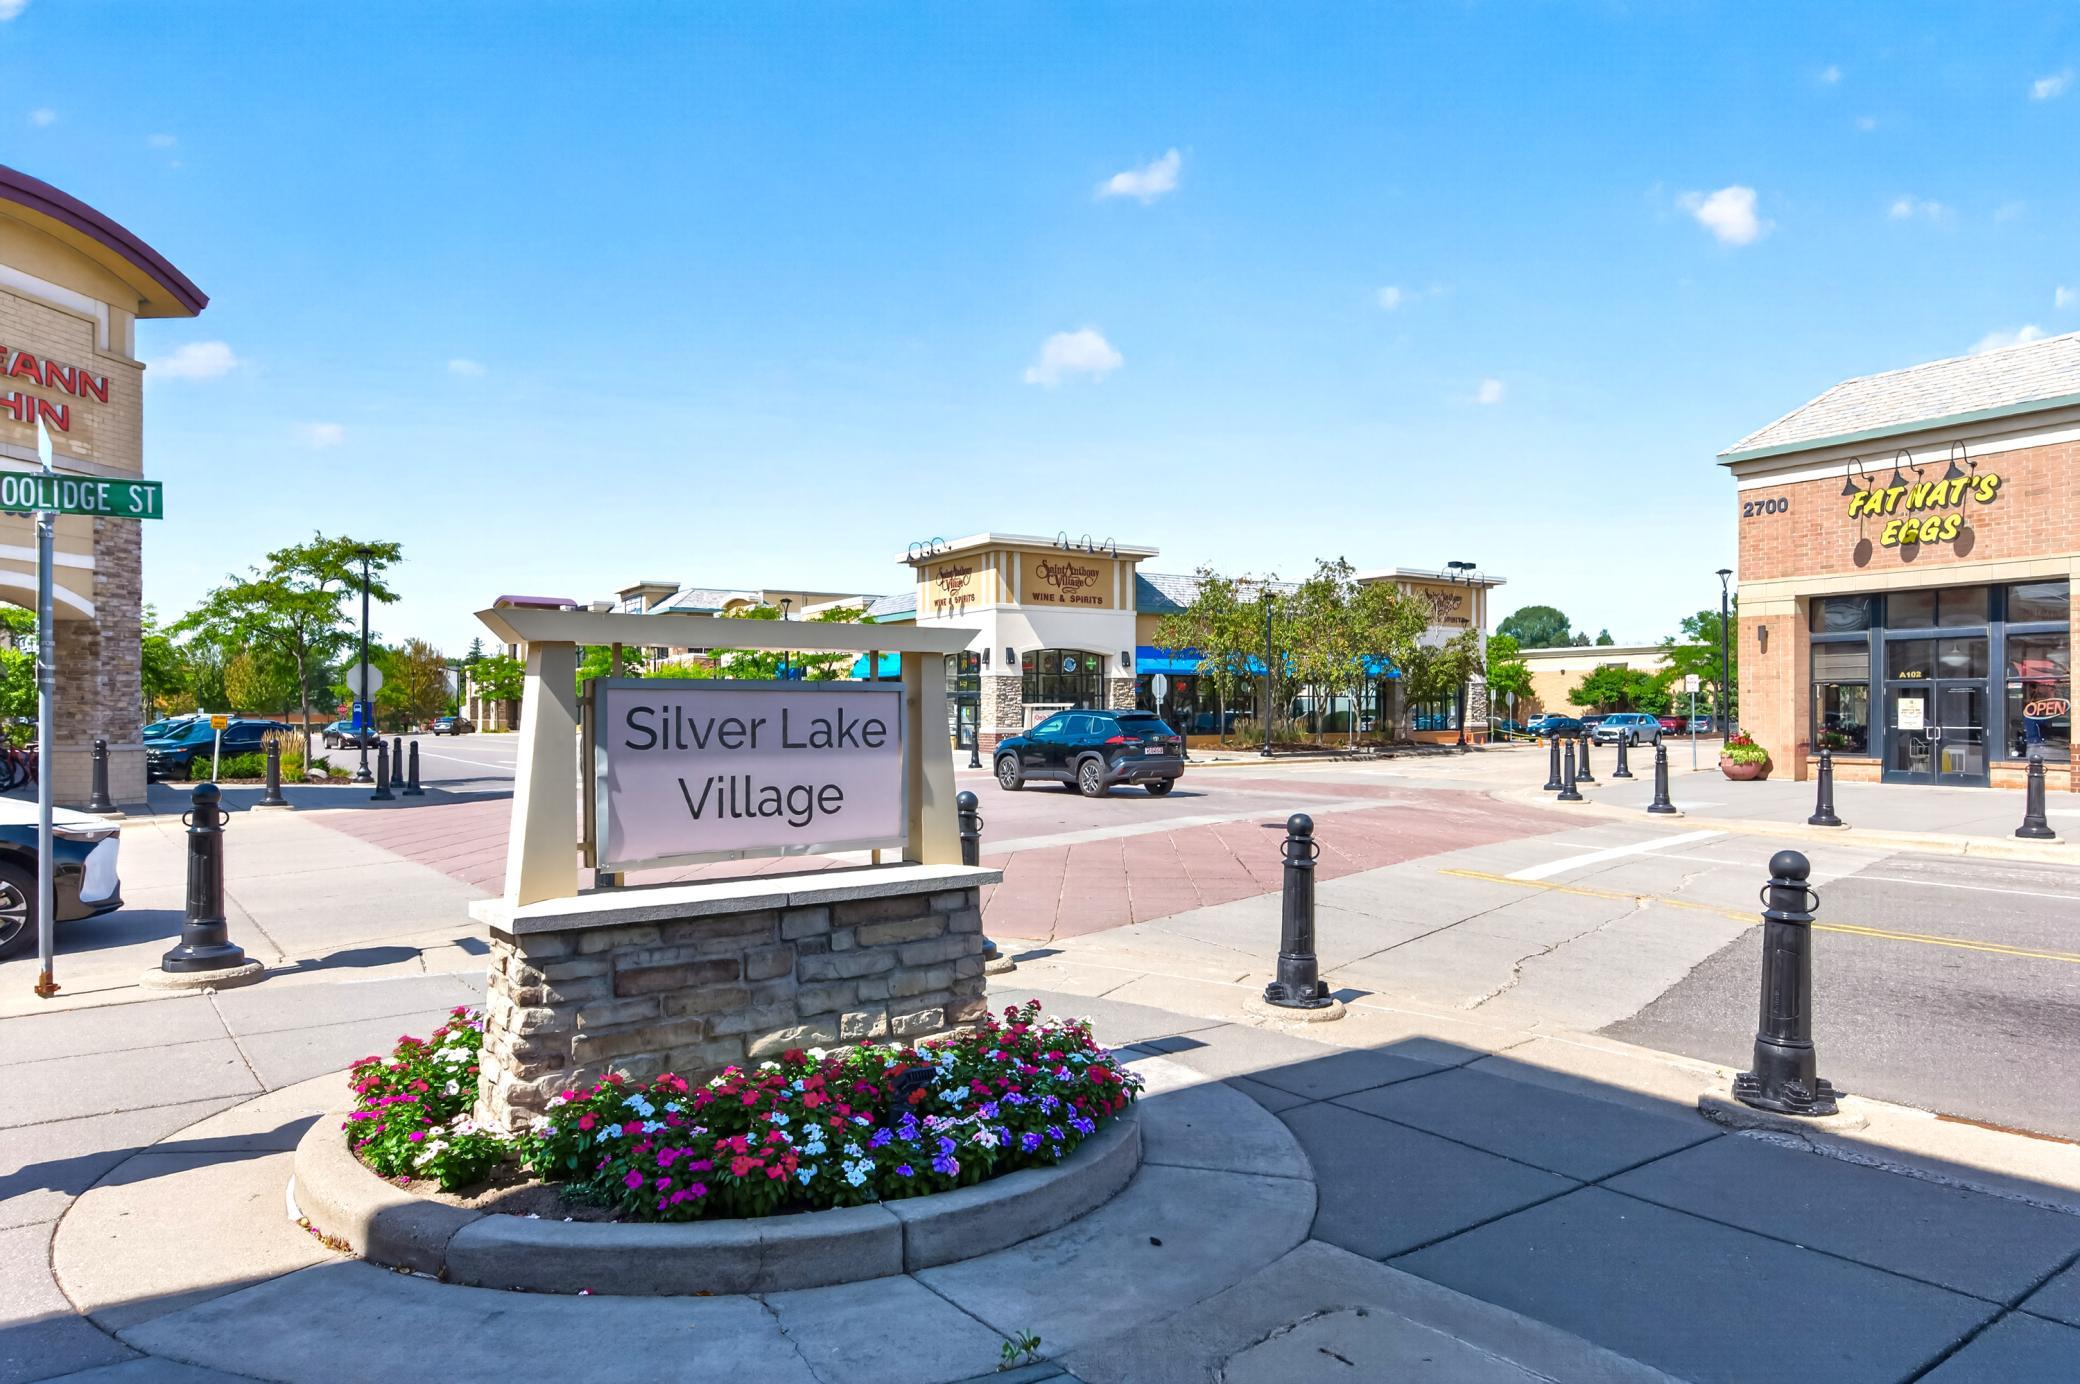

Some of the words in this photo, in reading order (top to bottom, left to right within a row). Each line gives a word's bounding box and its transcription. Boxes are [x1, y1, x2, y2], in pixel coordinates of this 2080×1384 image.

[129, 485, 156, 513] ST
[1743, 497, 1788, 518] 2700
[1848, 486, 1906, 518] FAT
[1905, 473, 2001, 510] NAT'S
[1880, 513, 1962, 547] EGGS
[1047, 574, 1085, 594] Village
[1032, 592, 1055, 602] WINE
[1059, 594, 1066, 603] &
[1070, 594, 1103, 605] SPIRITS
[1899, 671, 1922, 679] A102
[2025, 701, 2067, 717] OPEN
[624, 706, 767, 750] Silver
[781, 707, 888, 750] Lake
[678, 774, 845, 829] Village
